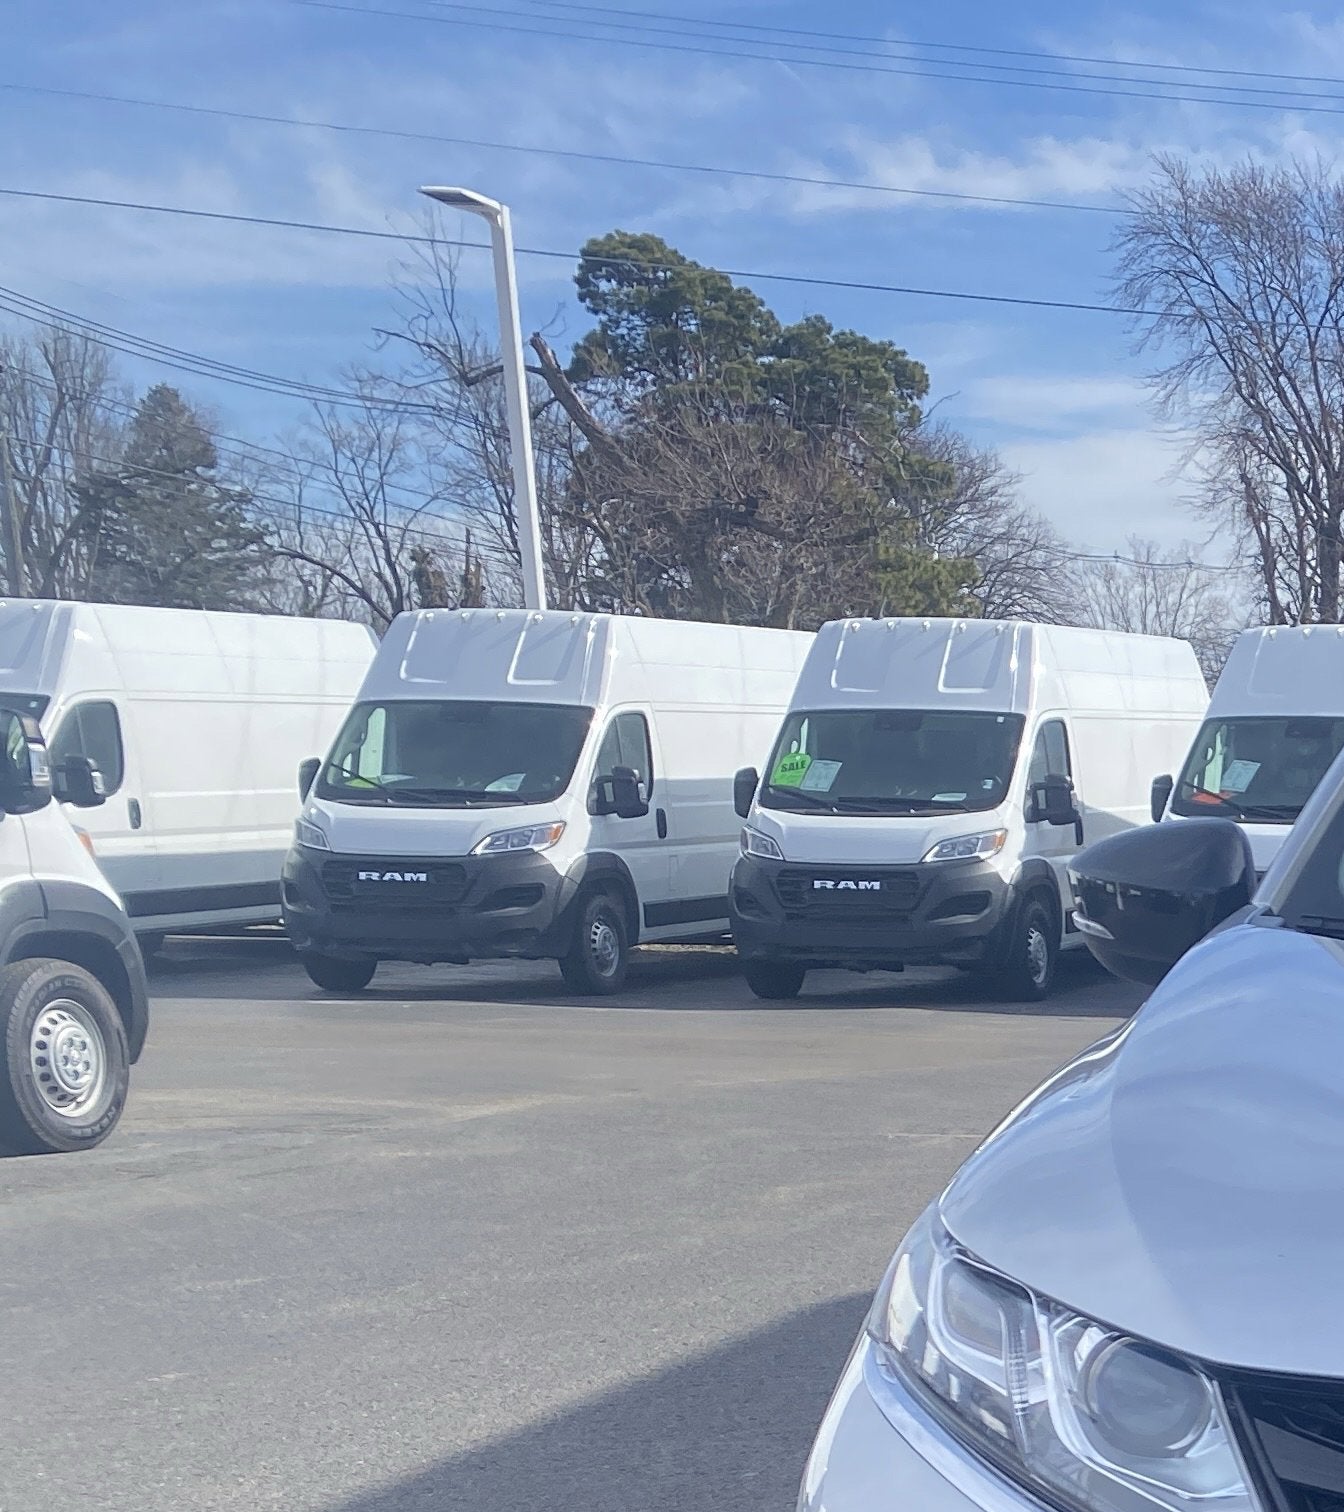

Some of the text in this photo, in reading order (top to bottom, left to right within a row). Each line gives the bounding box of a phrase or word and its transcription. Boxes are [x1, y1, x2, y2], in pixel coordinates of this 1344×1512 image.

[780, 760, 806, 772] SALE
[358, 871, 428, 882] RAM
[813, 880, 881, 890] RAM
